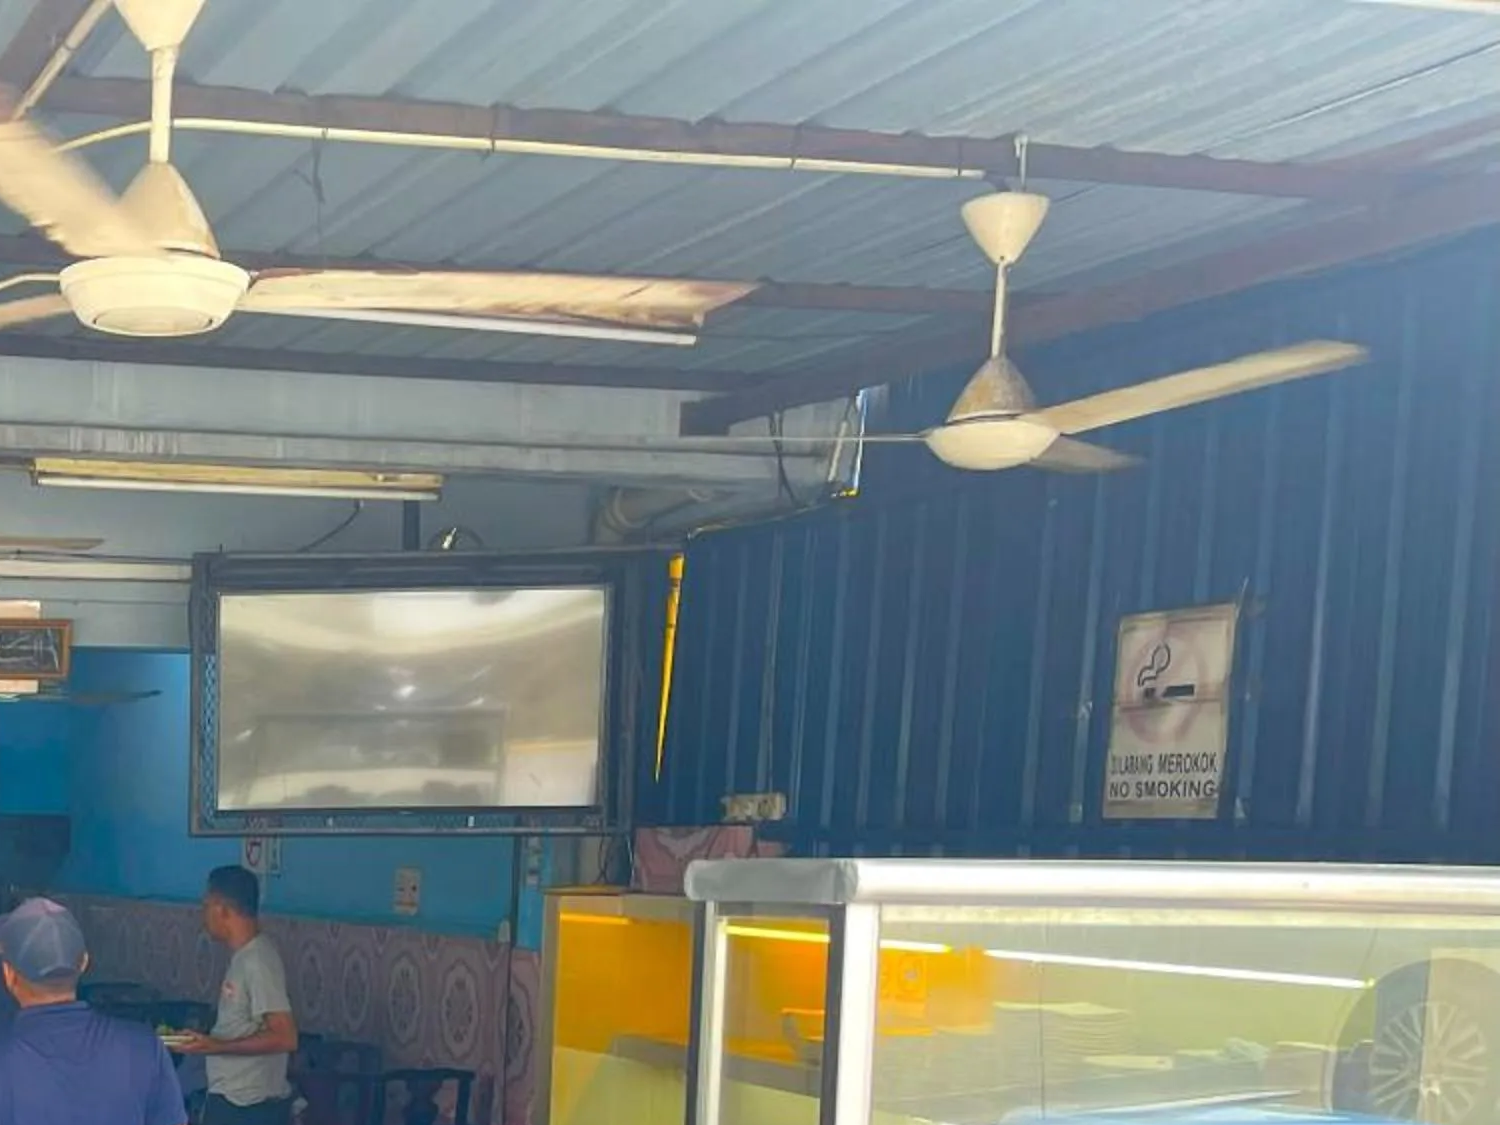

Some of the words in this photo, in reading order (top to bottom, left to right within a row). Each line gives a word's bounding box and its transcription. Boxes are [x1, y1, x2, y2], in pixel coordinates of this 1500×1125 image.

[1158, 751, 1218, 774] MEROKOK
[1109, 781, 1130, 798] NO
[1135, 779, 1216, 798] SMOKING
